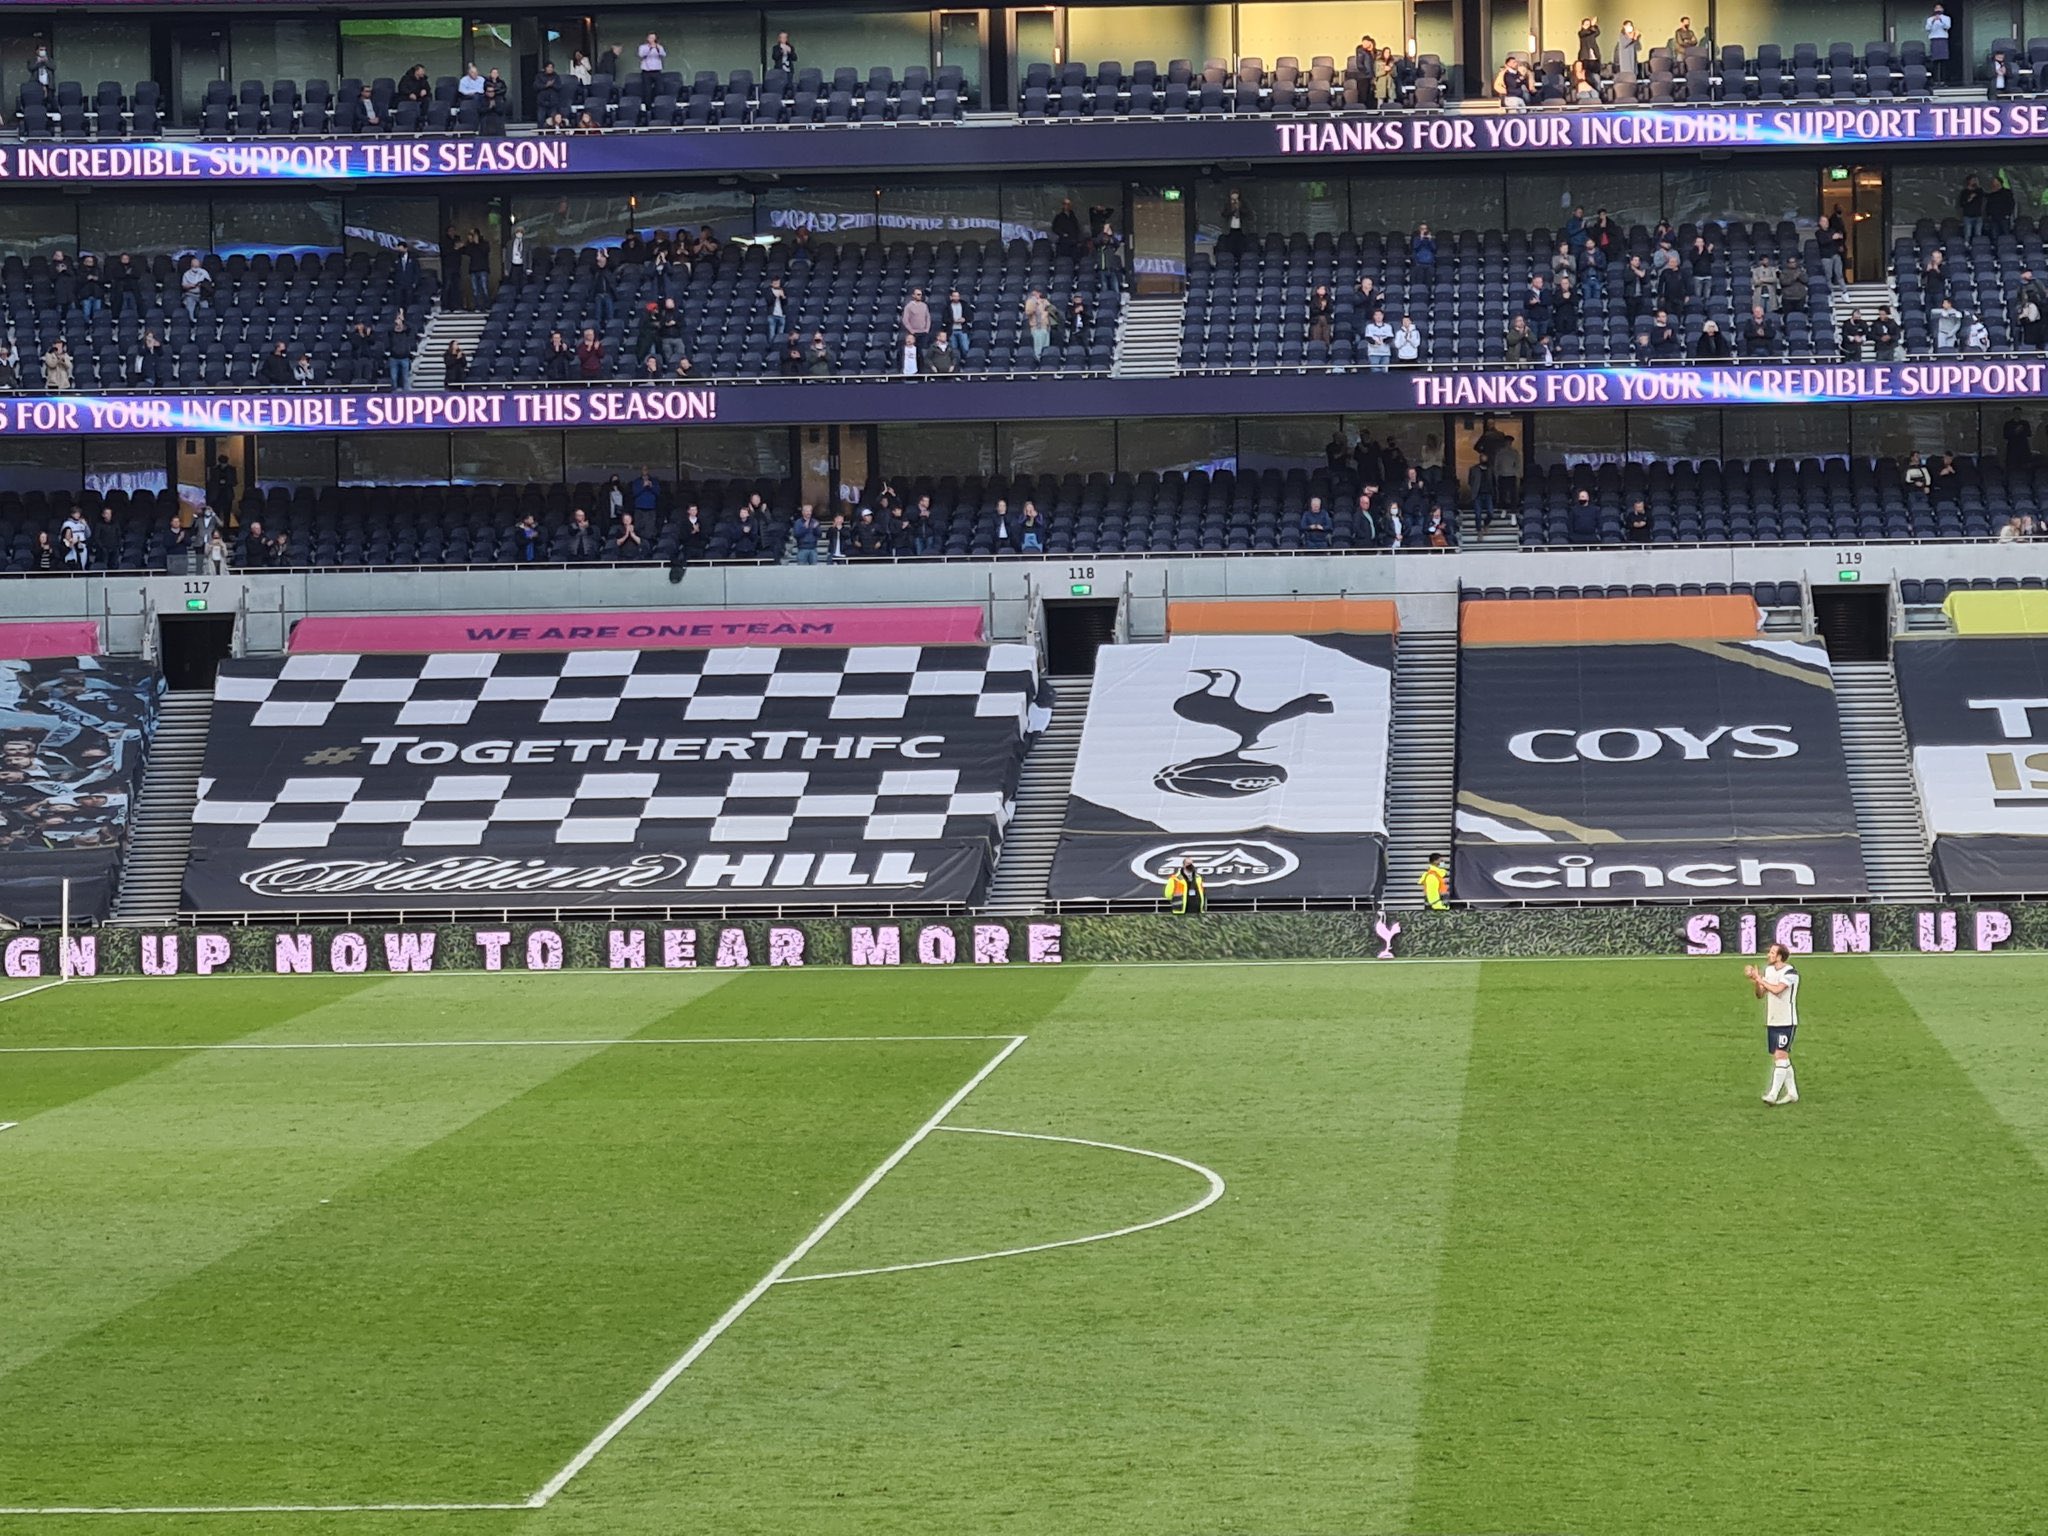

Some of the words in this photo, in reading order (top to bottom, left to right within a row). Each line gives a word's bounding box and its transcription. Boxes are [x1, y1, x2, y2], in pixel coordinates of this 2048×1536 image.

[1277, 121, 1402, 151] THANKS
[1413, 118, 1476, 149] FOR
[1484, 117, 1573, 147] YOUR
[1581, 112, 1763, 145] INCREDIBLE
[1773, 109, 1920, 141] SUPPORT
[1929, 107, 2001, 137] THIS
[18, 147, 200, 177] INCREDIBLE
[209, 146, 353, 176] SUPPORT
[361, 144, 430, 172] THIS
[438, 141, 567, 171] SEASON!
[1413, 375, 1537, 405] THANKS
[1547, 373, 1609, 402] FOR
[1618, 371, 1704, 400] YOUR
[1712, 367, 1893, 398] INCREDIBLE
[1901, 364, 2047, 394] SUPPORT
[17, 402, 79, 430] FOR
[89, 400, 173, 429] YOUR
[182, 398, 358, 427] INCREDIBLE
[366, 395, 505, 425] SUPPORT
[513, 393, 582, 422] THIS
[589, 391, 717, 421] SEASON!
[1069, 567, 1095, 579] 118
[1836, 552, 1862, 565] 119
[184, 581, 210, 594] 117
[466, 628, 532, 641] WE
[536, 626, 620, 640] ARE
[626, 625, 719, 637] ONE
[721, 623, 834, 635] TEAM
[1508, 725, 1800, 763] COYS
[239, 854, 687, 897] William
[686, 852, 928, 888] HILL
[1158, 865, 1270, 875] SORTS
[1160, 847, 1270, 868] EA
[1493, 855, 1816, 889] cinch
[141, 934, 231, 975] UP
[275, 932, 436, 973] NOW
[475, 929, 564, 971] TO
[608, 925, 805, 969] HEAR
[850, 923, 1063, 966] MORE
[1686, 911, 1871, 955] SIGN
[1918, 910, 2013, 953] UP
